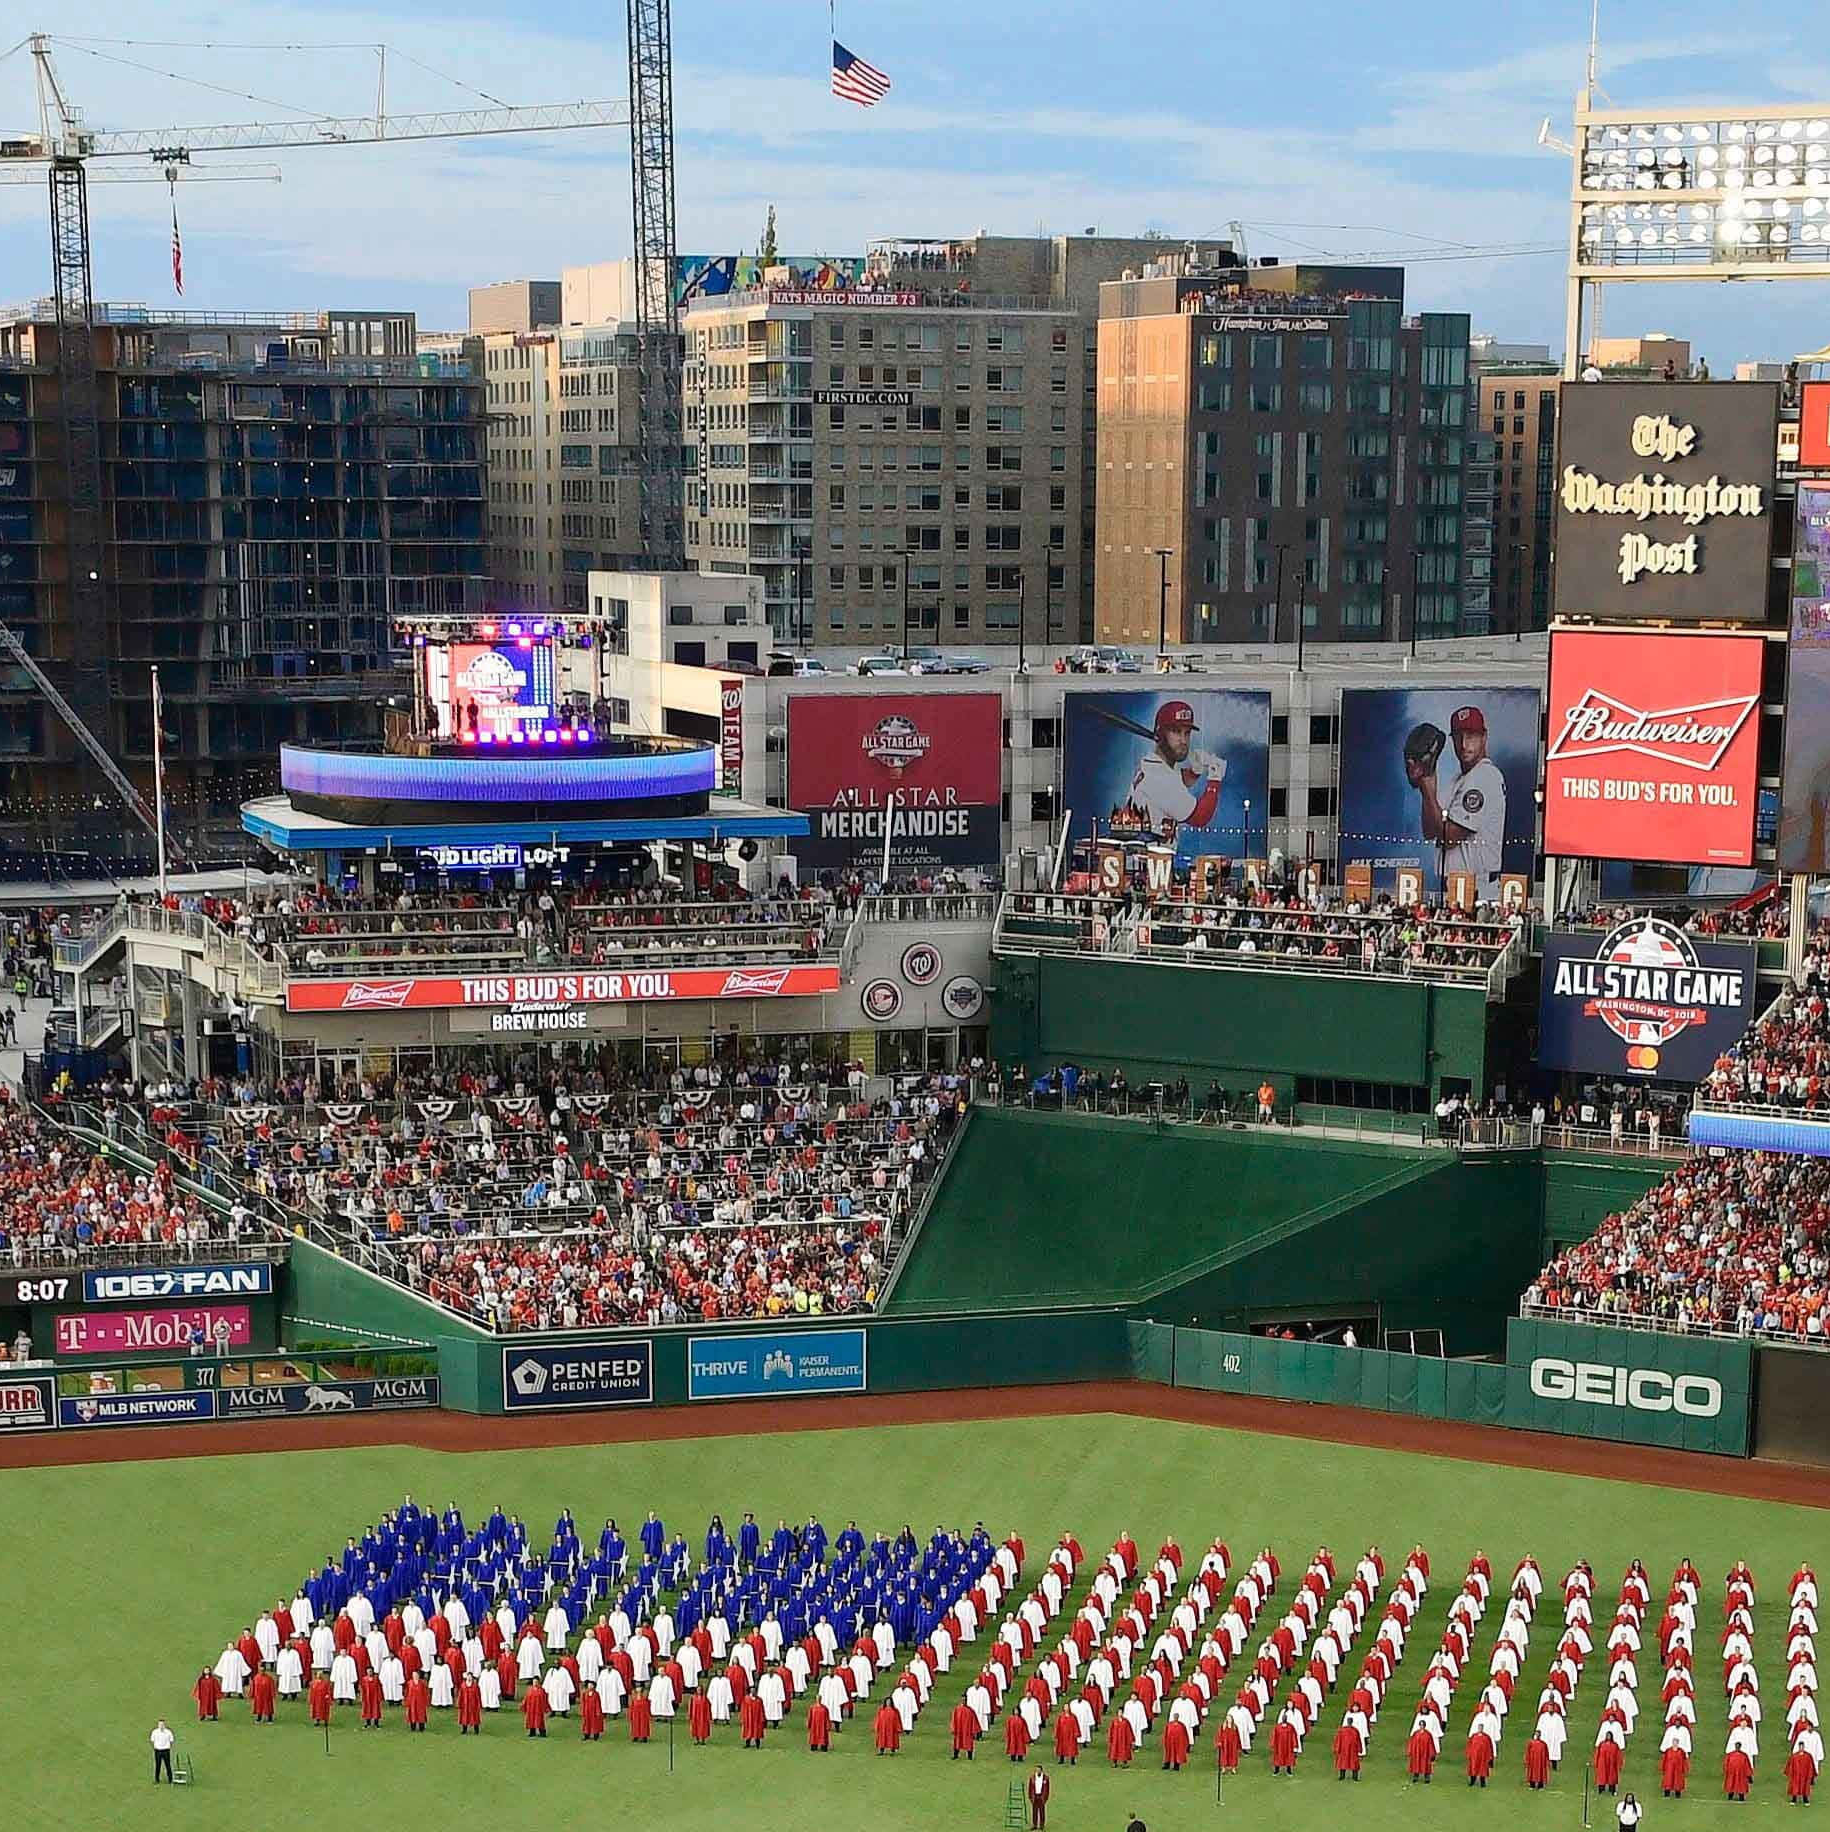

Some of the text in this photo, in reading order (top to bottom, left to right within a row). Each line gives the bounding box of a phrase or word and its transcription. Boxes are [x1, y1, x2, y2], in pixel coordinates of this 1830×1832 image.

[772, 292, 916, 305] NATS MAGIC NUMBER 73
[818, 391, 909, 404] FIRSTDC.COM
[1630, 415, 1695, 464] The
[1563, 466, 1763, 527] Washington
[1617, 530, 1698, 585] Post
[1566, 706, 1733, 745] Budweiser
[862, 735, 930, 748] ALL STAR GAME
[833, 787, 958, 807] ALL STAR
[1562, 778, 1738, 806] THIS BUD'S FOR YOU.
[822, 810, 969, 838] MERCHANDISE
[462, 980, 507, 1002] THIS
[514, 978, 578, 1001] BUD'S
[582, 977, 623, 999] FOR
[627, 975, 674, 998] YOU.
[1554, 962, 1743, 1006] ALL STAR GAME
[492, 1011, 587, 1031] BREW HOUSE
[18, 1279, 69, 1301] 8:07
[183, 1269, 261, 1294] FAN
[552, 1360, 641, 1380] PENFED
[692, 1360, 748, 1377] THRIVE
[1223, 1354, 1240, 1374] 402
[196, 1368, 215, 1387] 377
[552, 1377, 640, 1392] CREDIT UNION
[1530, 1357, 1723, 1418] GEICO
[229, 1379, 427, 1407] MGM MGM
[99, 1397, 196, 1416] MLB NETWORK
